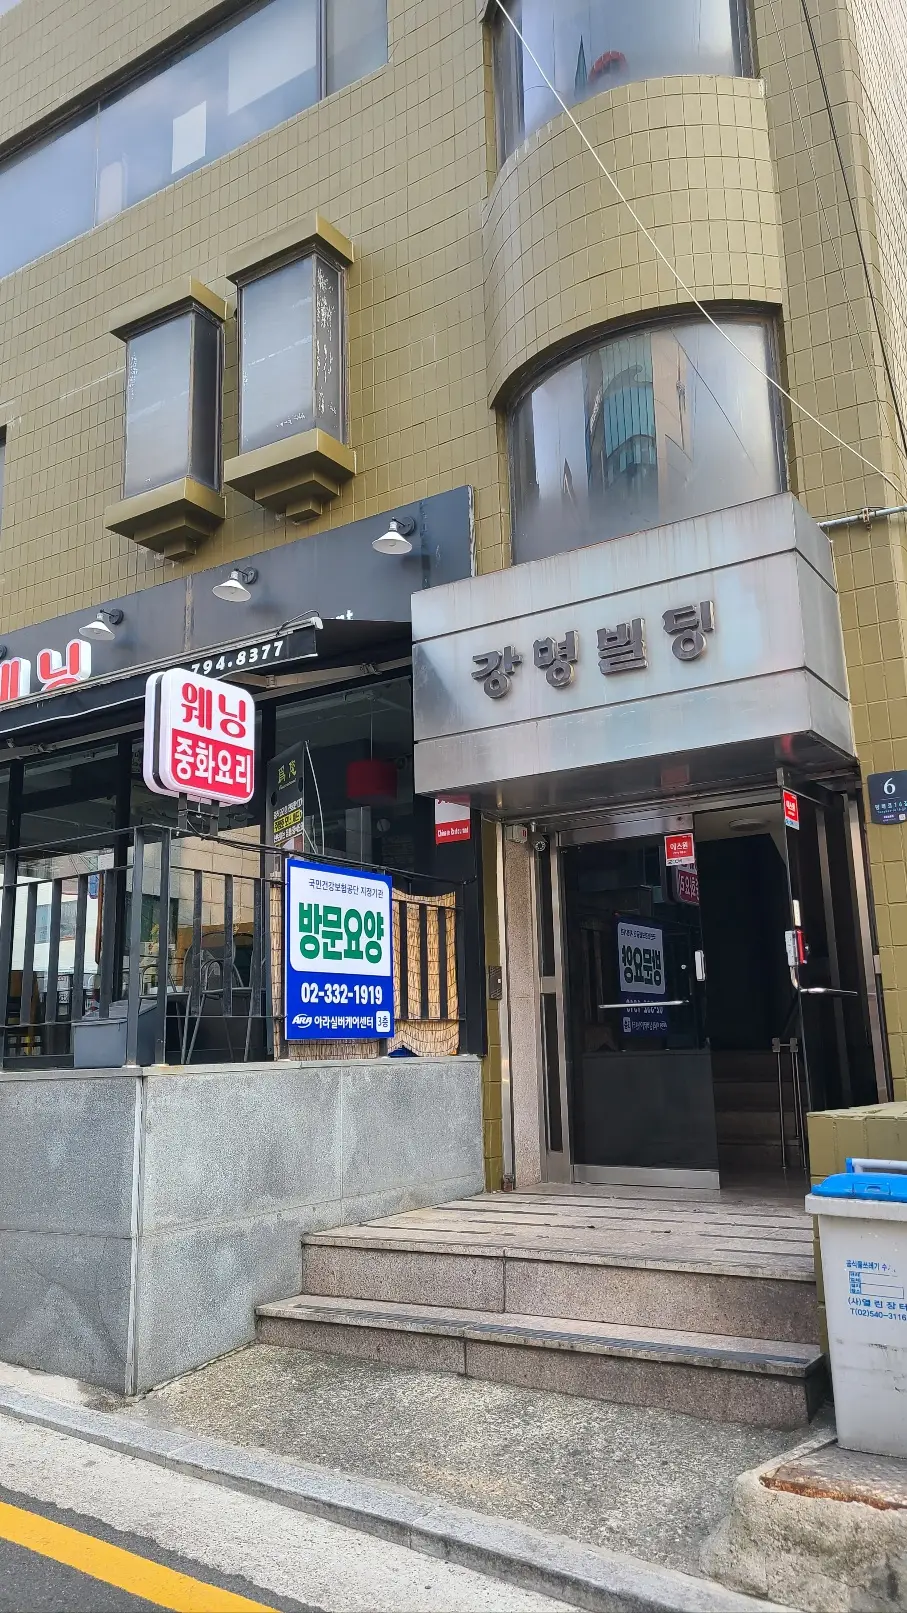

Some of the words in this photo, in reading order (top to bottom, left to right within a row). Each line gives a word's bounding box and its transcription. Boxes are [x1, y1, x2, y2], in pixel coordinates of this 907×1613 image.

[471, 600, 715, 700] 강명빌딩
[181, 682, 246, 738] 웨닝
[174, 736, 251, 793] 중화요리
[883, 777, 896, 795] 6
[669, 841, 689, 851] 에스원
[308, 878, 360, 896] 국민건강보험공단
[360, 886, 384, 899] 지정기관
[299, 902, 385, 964] 방문요양
[301, 982, 383, 1005] 02-332-1919
[314, 1016, 374, 1029] 아라실버케어센터
[377, 1016, 389, 1028] 3층
[850, 1307, 907, 1321] T(02)540-3116
